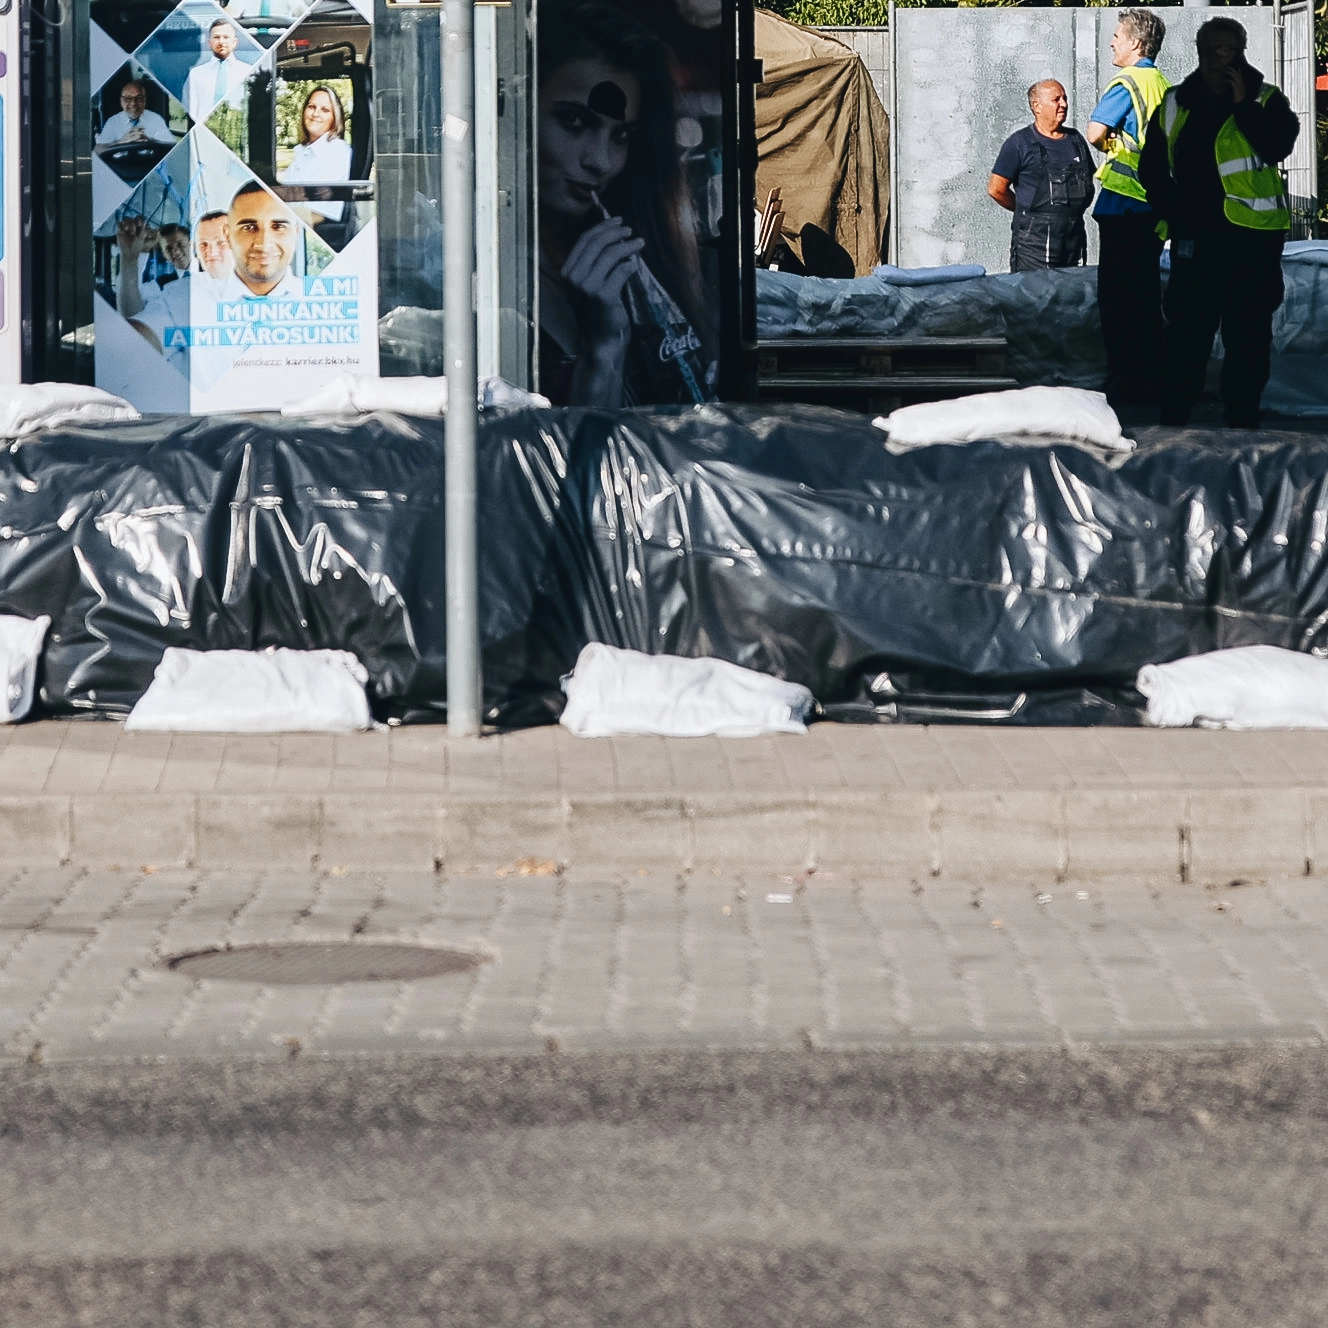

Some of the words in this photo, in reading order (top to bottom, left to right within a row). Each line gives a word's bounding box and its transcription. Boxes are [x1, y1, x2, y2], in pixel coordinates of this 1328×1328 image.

[310, 278, 328, 295] A
[331, 277, 357, 295] MI
[171, 329, 188, 346] A
[194, 328, 220, 345] MI
[226, 322, 359, 345] VÁROSUNK!
